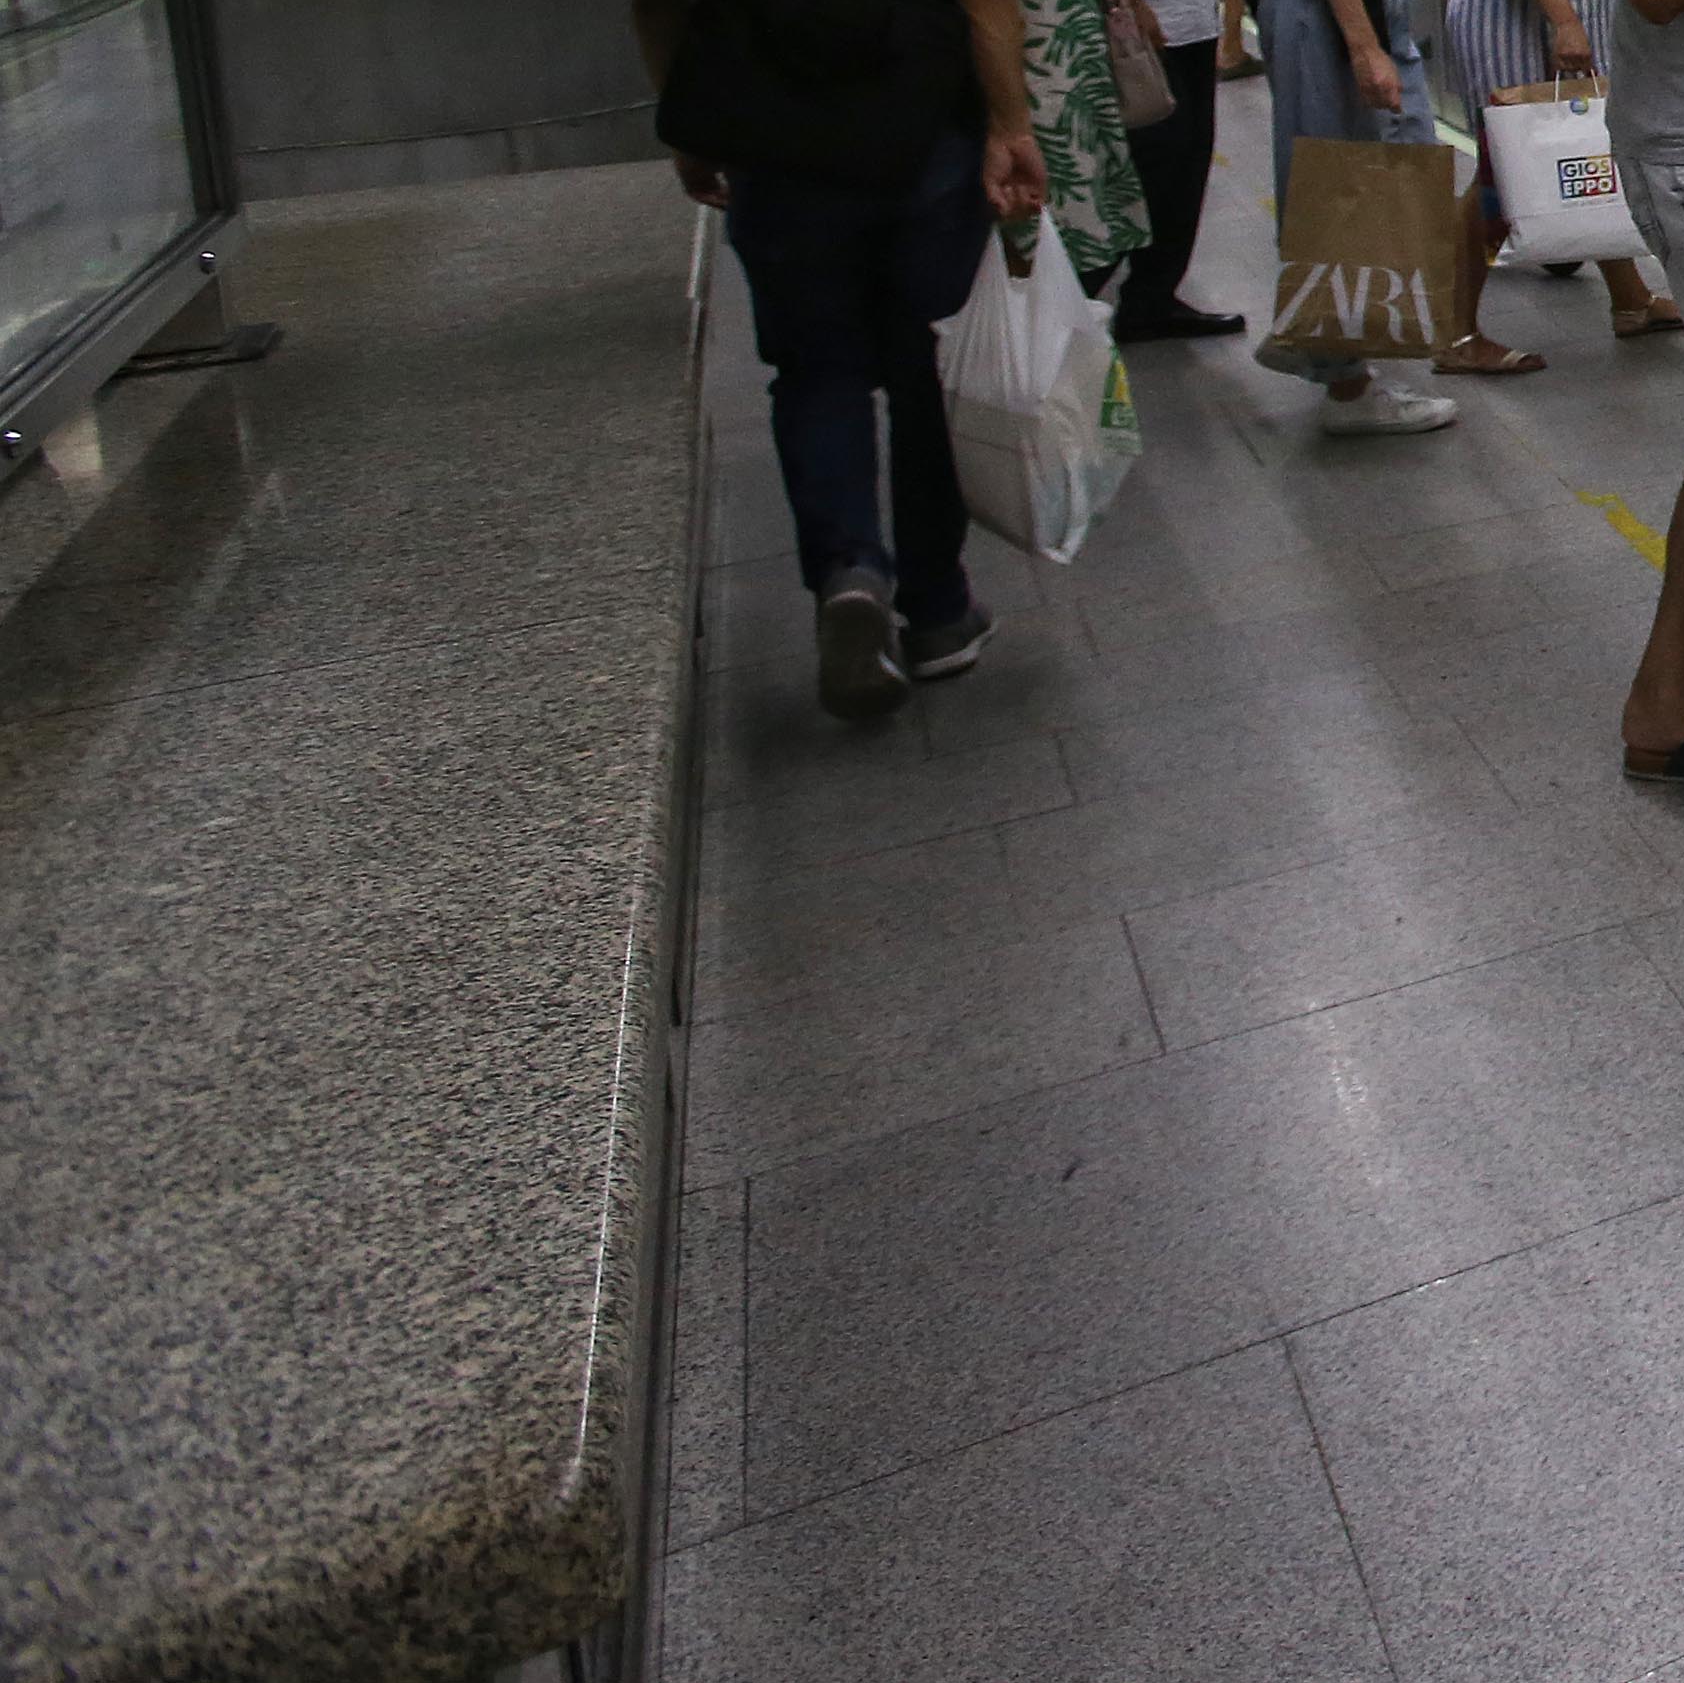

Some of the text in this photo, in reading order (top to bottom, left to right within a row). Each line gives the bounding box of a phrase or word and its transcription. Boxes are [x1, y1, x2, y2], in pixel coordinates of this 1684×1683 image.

[1564, 160, 1610, 177] GIOS
[1563, 179, 1612, 196] EPPO
[1272, 261, 1436, 345] ZARA
